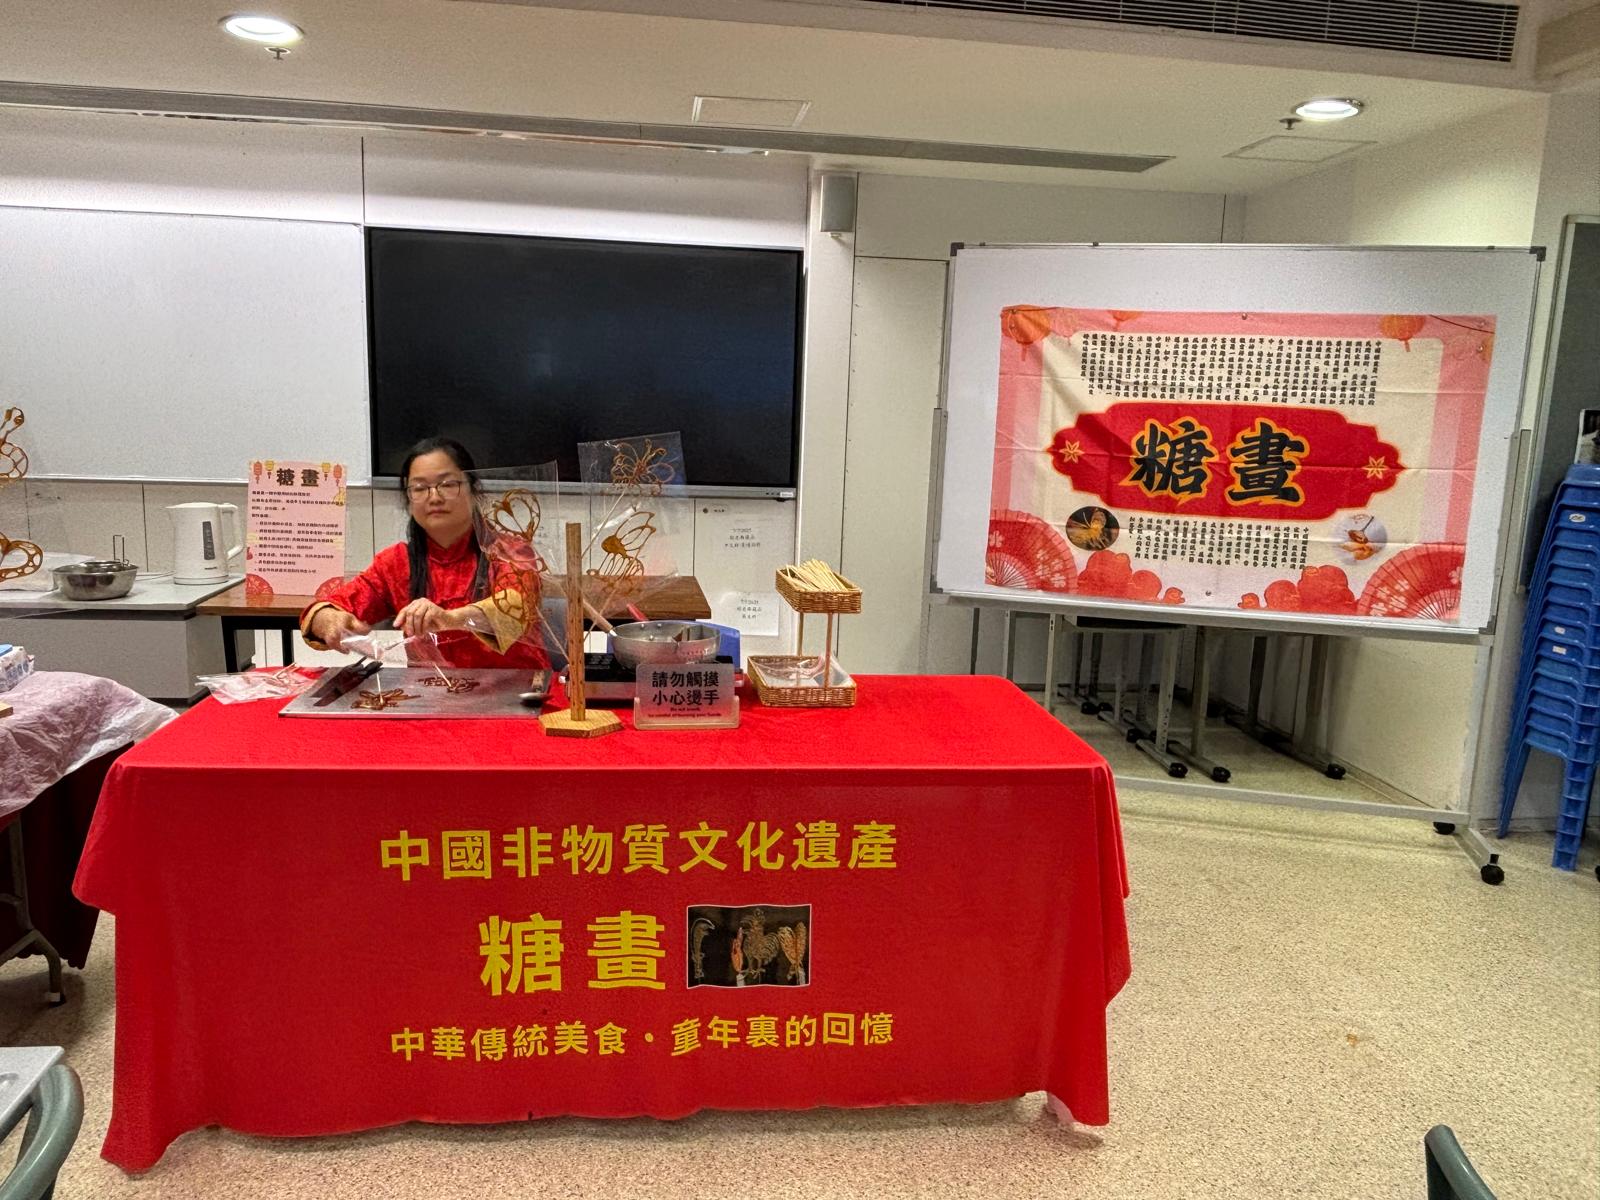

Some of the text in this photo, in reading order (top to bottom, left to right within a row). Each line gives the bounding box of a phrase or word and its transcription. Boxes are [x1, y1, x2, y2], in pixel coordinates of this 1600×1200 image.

[277, 468, 319, 487] 糖畫
[1122, 417, 1308, 505] 糖畫
[652, 671, 719, 687] 請勿觸摸
[652, 689, 720, 706] 小心燙手
[380, 821, 898, 881] 中國非物質文化遺產
[479, 910, 667, 996] 糖畫
